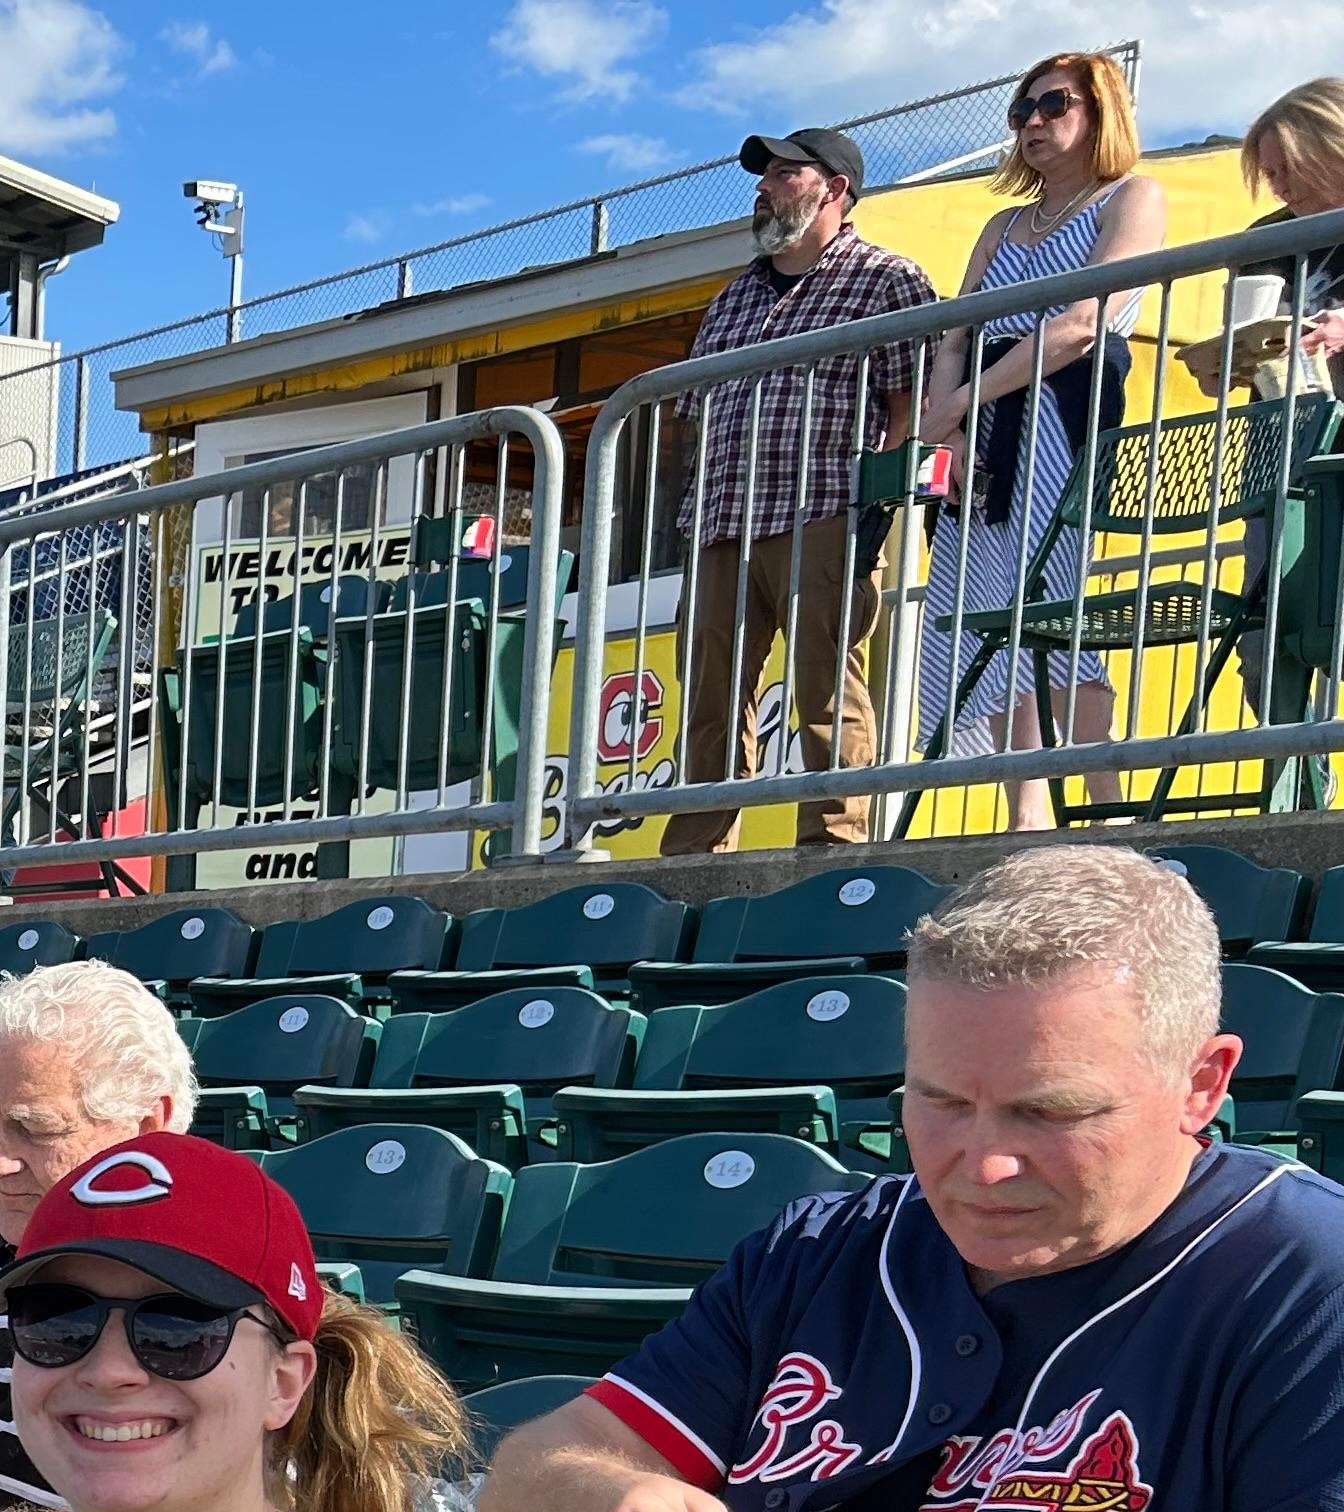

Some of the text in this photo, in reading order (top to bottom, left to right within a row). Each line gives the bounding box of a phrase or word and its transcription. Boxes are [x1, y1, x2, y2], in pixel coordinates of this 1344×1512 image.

[204, 537, 411, 583] WELCOME
[229, 583, 279, 615] TO
[848, 886, 865, 898] 12
[817, 1000, 839, 1012] 13
[375, 1150, 396, 1164] 13
[715, 1161, 743, 1178] 14
[726, 1352, 1105, 1498] Brves
